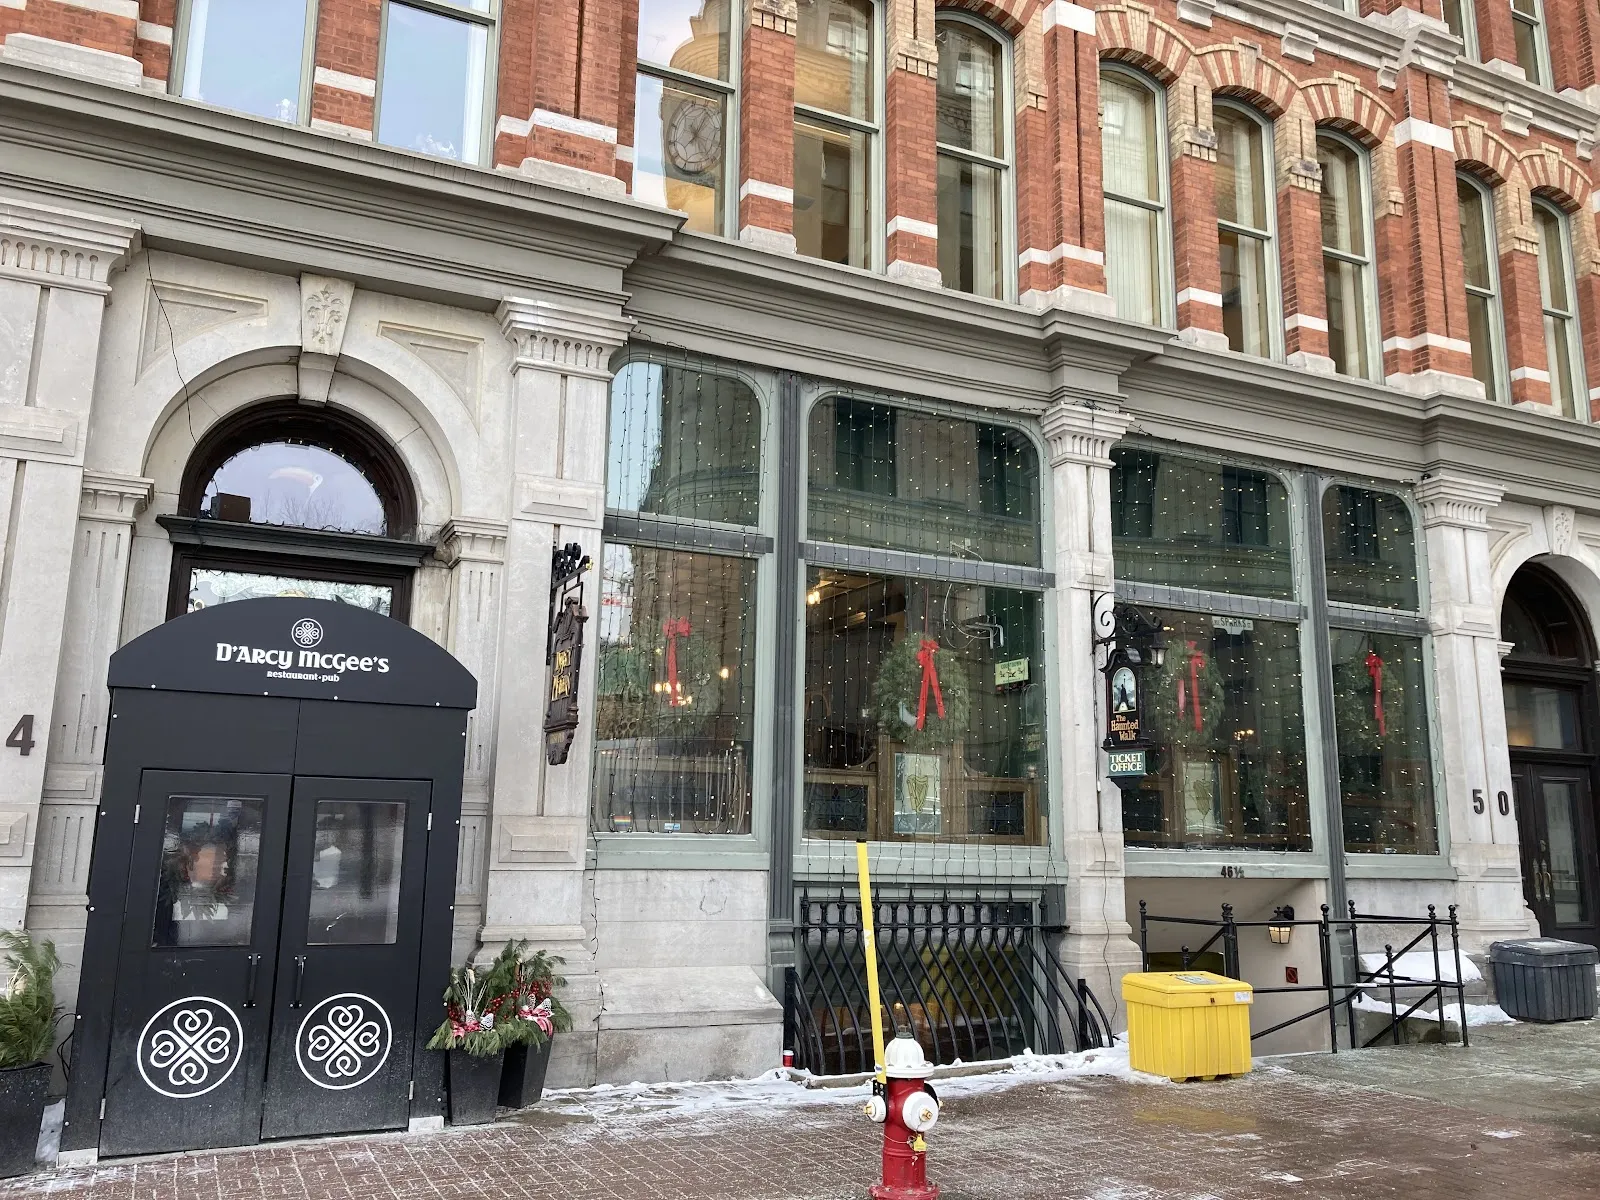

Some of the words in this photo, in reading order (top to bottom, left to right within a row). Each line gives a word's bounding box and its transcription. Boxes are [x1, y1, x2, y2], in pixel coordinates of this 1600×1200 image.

[1221, 617, 1246, 628] SPARKS
[1111, 720, 1139, 732] Haunted
[6, 715, 35, 756] 4
[1119, 731, 1136, 741] Walk
[1110, 753, 1142, 763] TICKET
[1110, 762, 1142, 772] OFFICE
